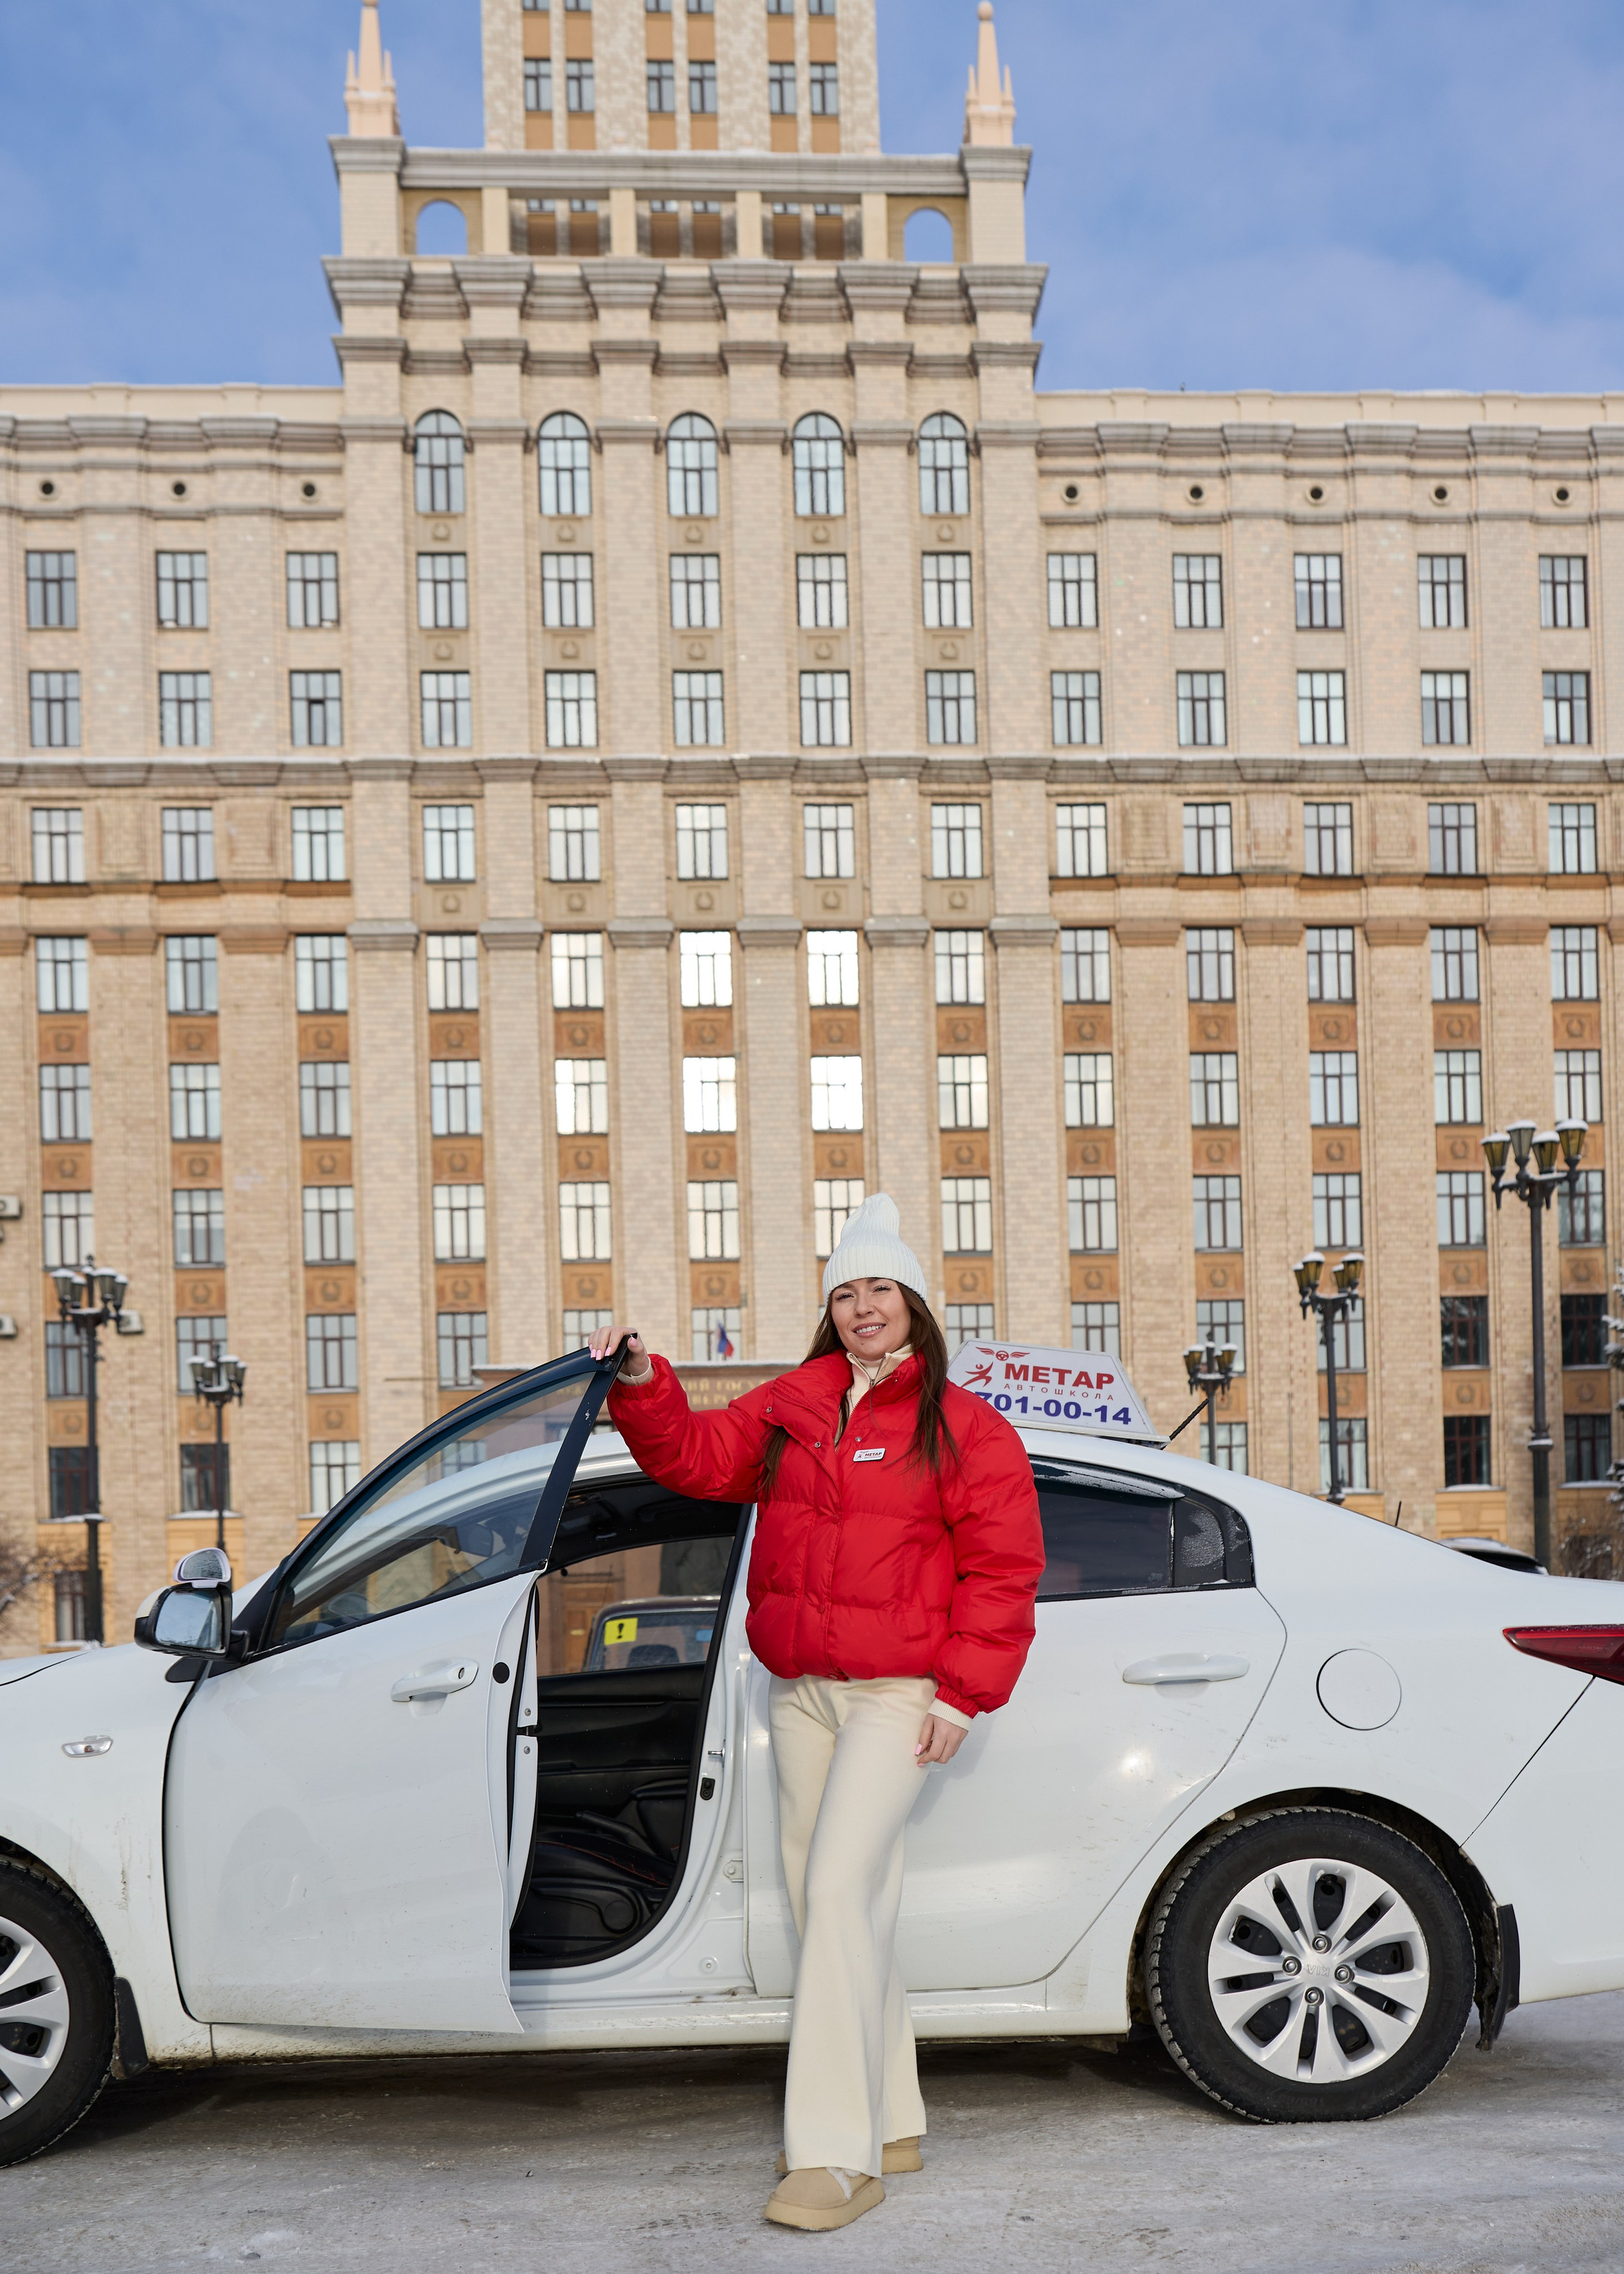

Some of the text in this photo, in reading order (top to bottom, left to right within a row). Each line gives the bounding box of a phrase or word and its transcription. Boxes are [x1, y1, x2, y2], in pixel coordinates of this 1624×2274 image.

[1004, 1362, 1115, 1390] МЕТАР
[1004, 1383, 1114, 1401] АВТОШКОЛА
[1307, 1964, 1330, 1977] KIA
